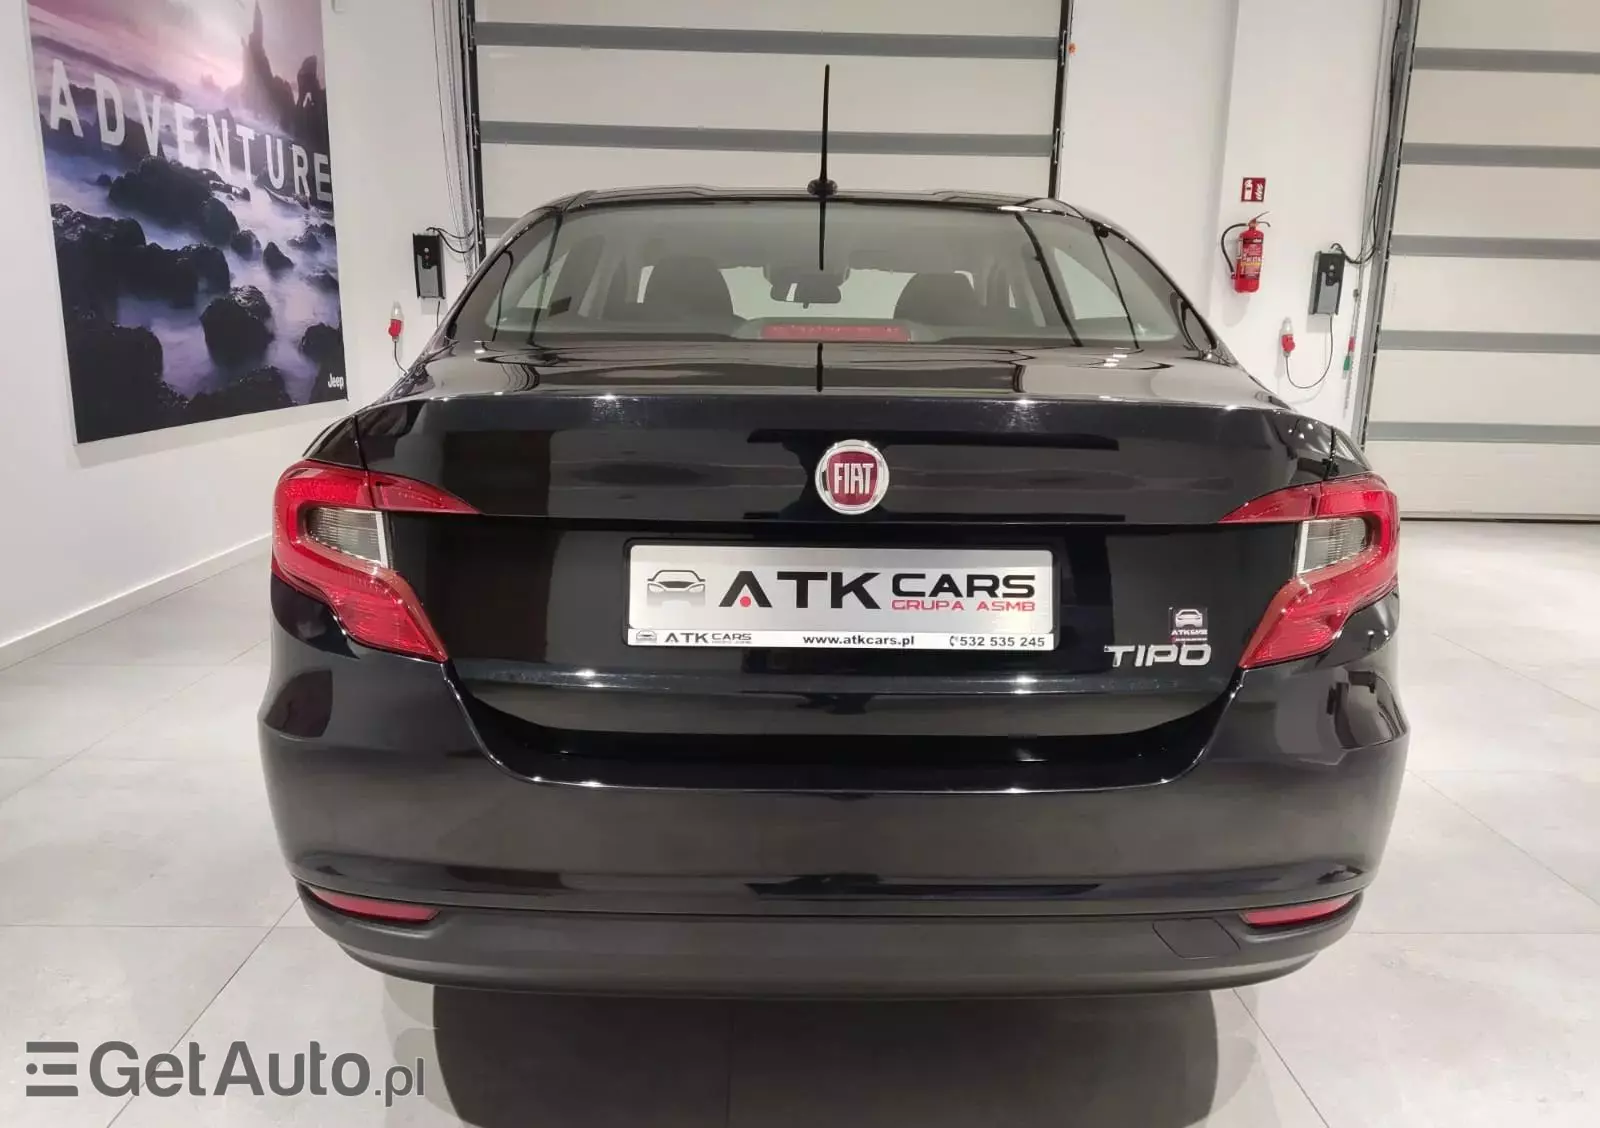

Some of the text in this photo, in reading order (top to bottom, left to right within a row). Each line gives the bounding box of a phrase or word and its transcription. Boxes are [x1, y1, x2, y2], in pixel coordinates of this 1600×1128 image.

[50, 58, 334, 202] ADVENTURE
[327, 372, 345, 390] Jeep
[833, 462, 875, 495] FIAT
[718, 570, 1036, 610] ATK CARS
[891, 599, 1036, 612] GRUPA ASMB
[664, 632, 752, 644] ATK CARS
[803, 635, 915, 647] www.atkcars.pl
[960, 636, 1045, 647] 532 535 245
[1103, 643, 1212, 667] TIPO
